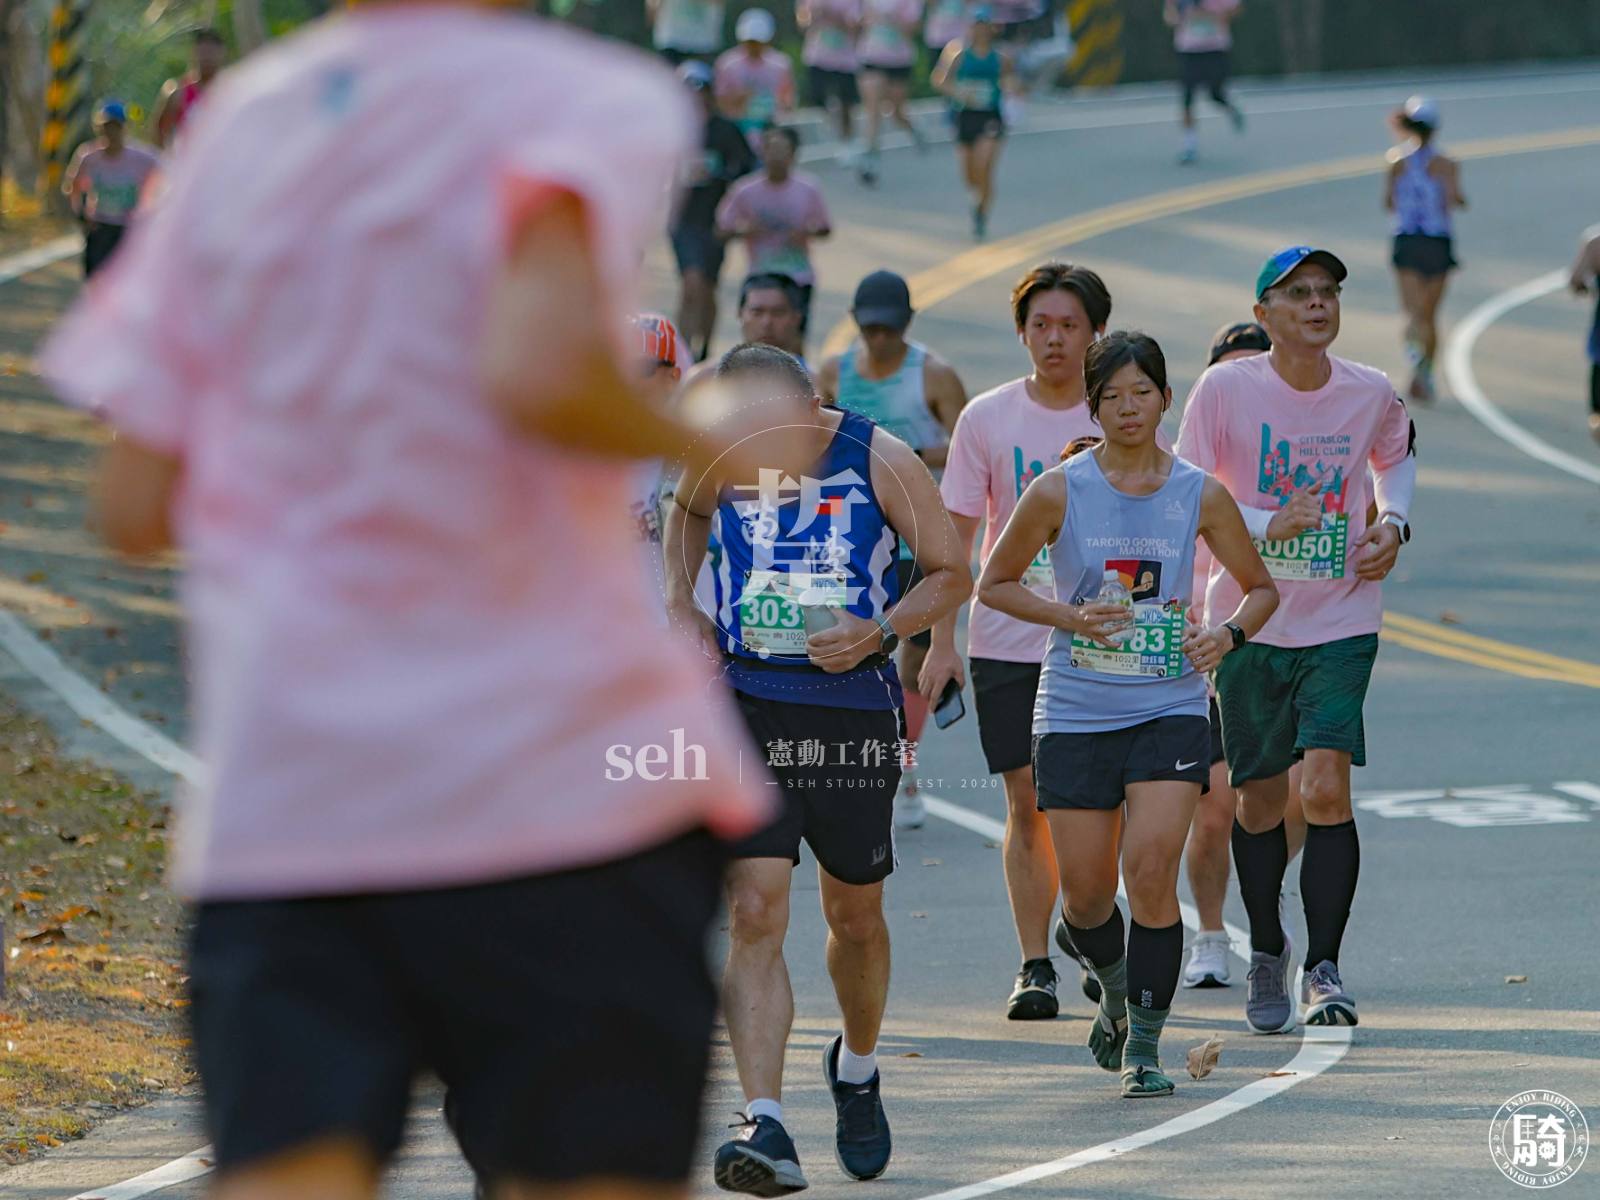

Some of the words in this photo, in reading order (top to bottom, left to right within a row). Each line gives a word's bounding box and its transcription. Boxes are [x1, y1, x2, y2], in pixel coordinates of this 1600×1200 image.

[1300, 447, 1320, 456] HILL
[1322, 447, 1351, 456] CLIMB
[1086, 538, 1130, 548] TAROKO
[1132, 538, 1168, 549] GORGE
[1119, 546, 1180, 558] MARATHON
